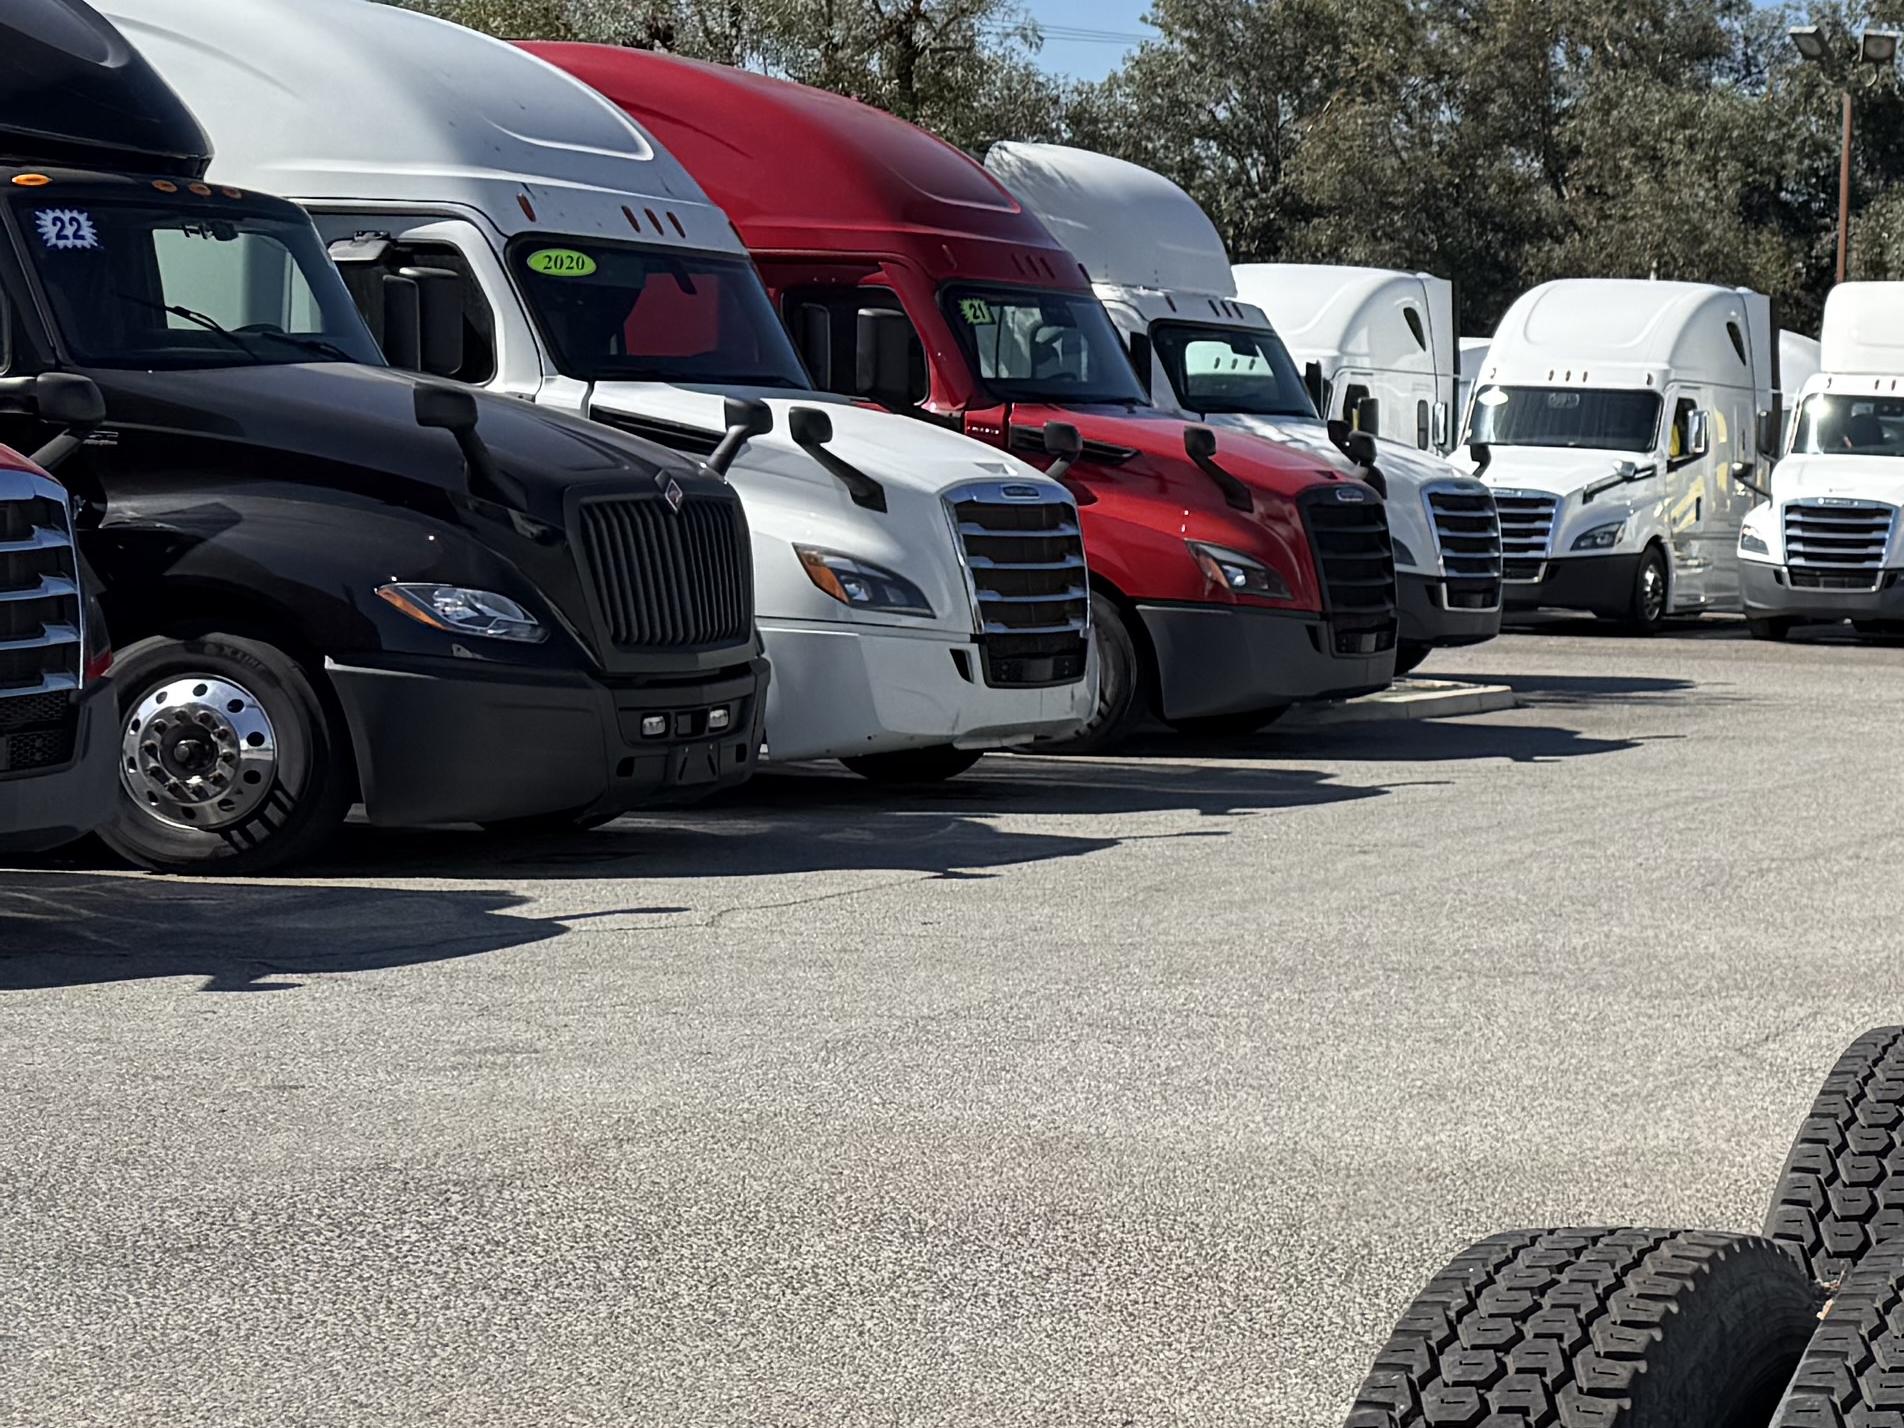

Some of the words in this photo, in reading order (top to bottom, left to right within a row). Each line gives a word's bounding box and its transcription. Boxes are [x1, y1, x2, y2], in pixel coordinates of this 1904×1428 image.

[51, 215, 87, 241] 22
[542, 254, 586, 271] 2020
[968, 302, 986, 320] 21
